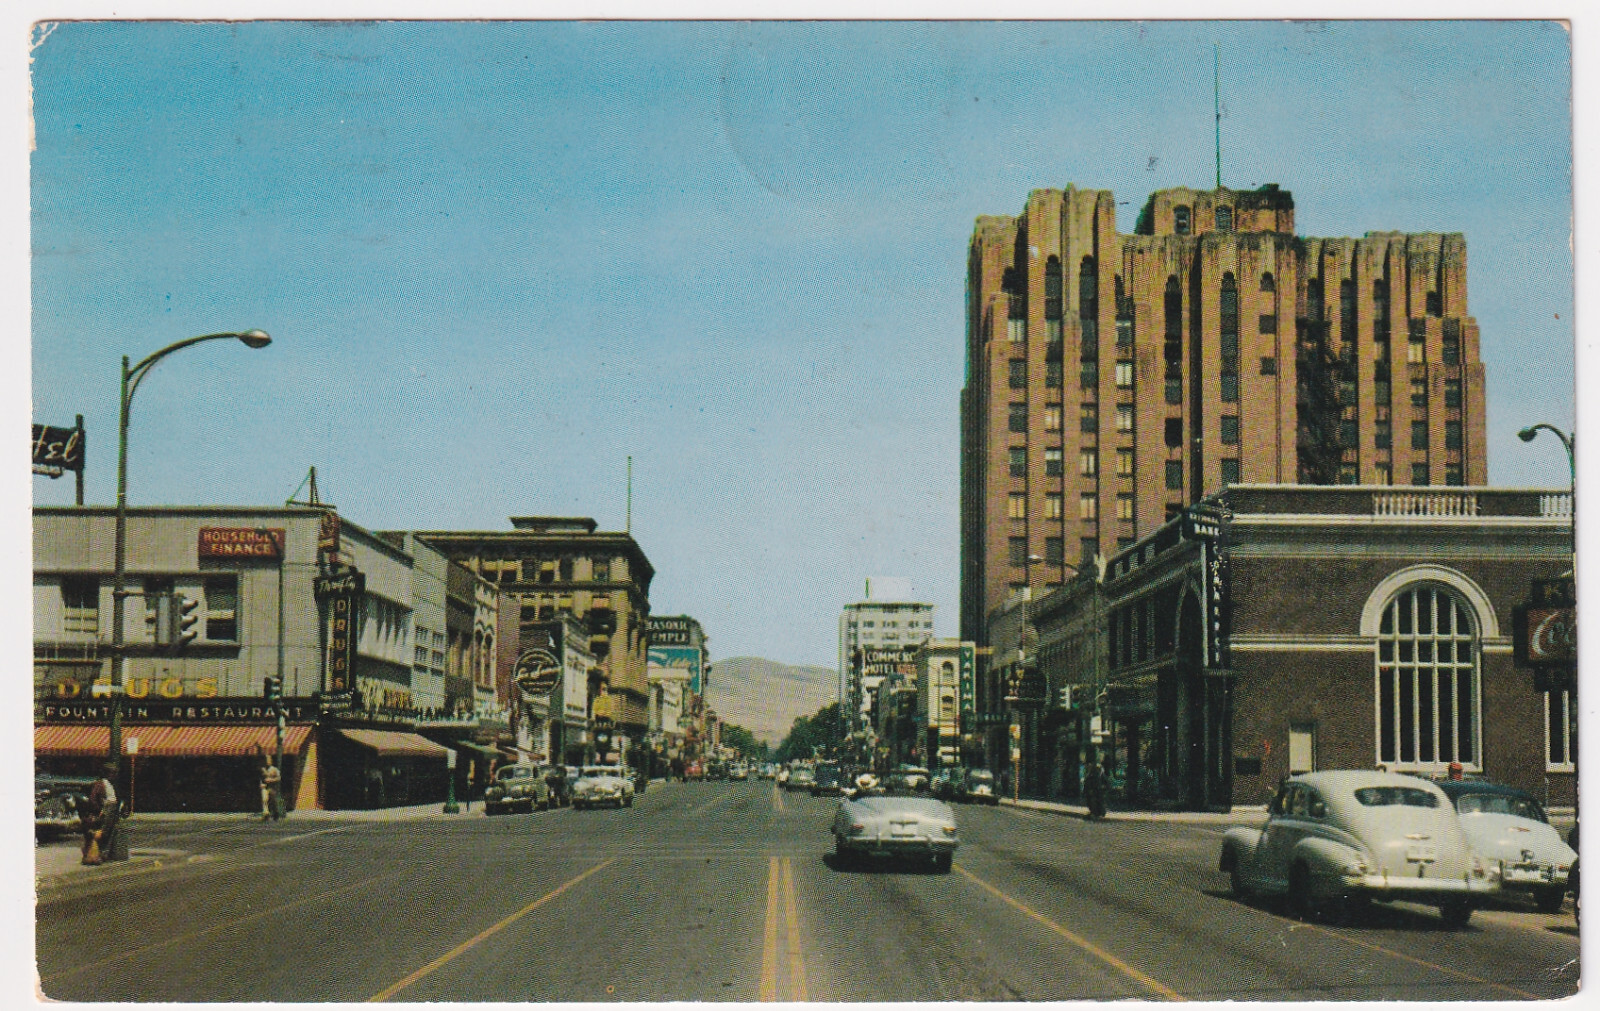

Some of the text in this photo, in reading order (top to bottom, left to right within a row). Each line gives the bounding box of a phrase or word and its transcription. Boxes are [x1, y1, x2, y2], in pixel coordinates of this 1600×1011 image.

[211, 544, 271, 555] FINANCE
[651, 632, 688, 642] EMPLE
[334, 600, 346, 690] DRUGS
[46, 706, 302, 718] FOUNTIN RESTAURANT
